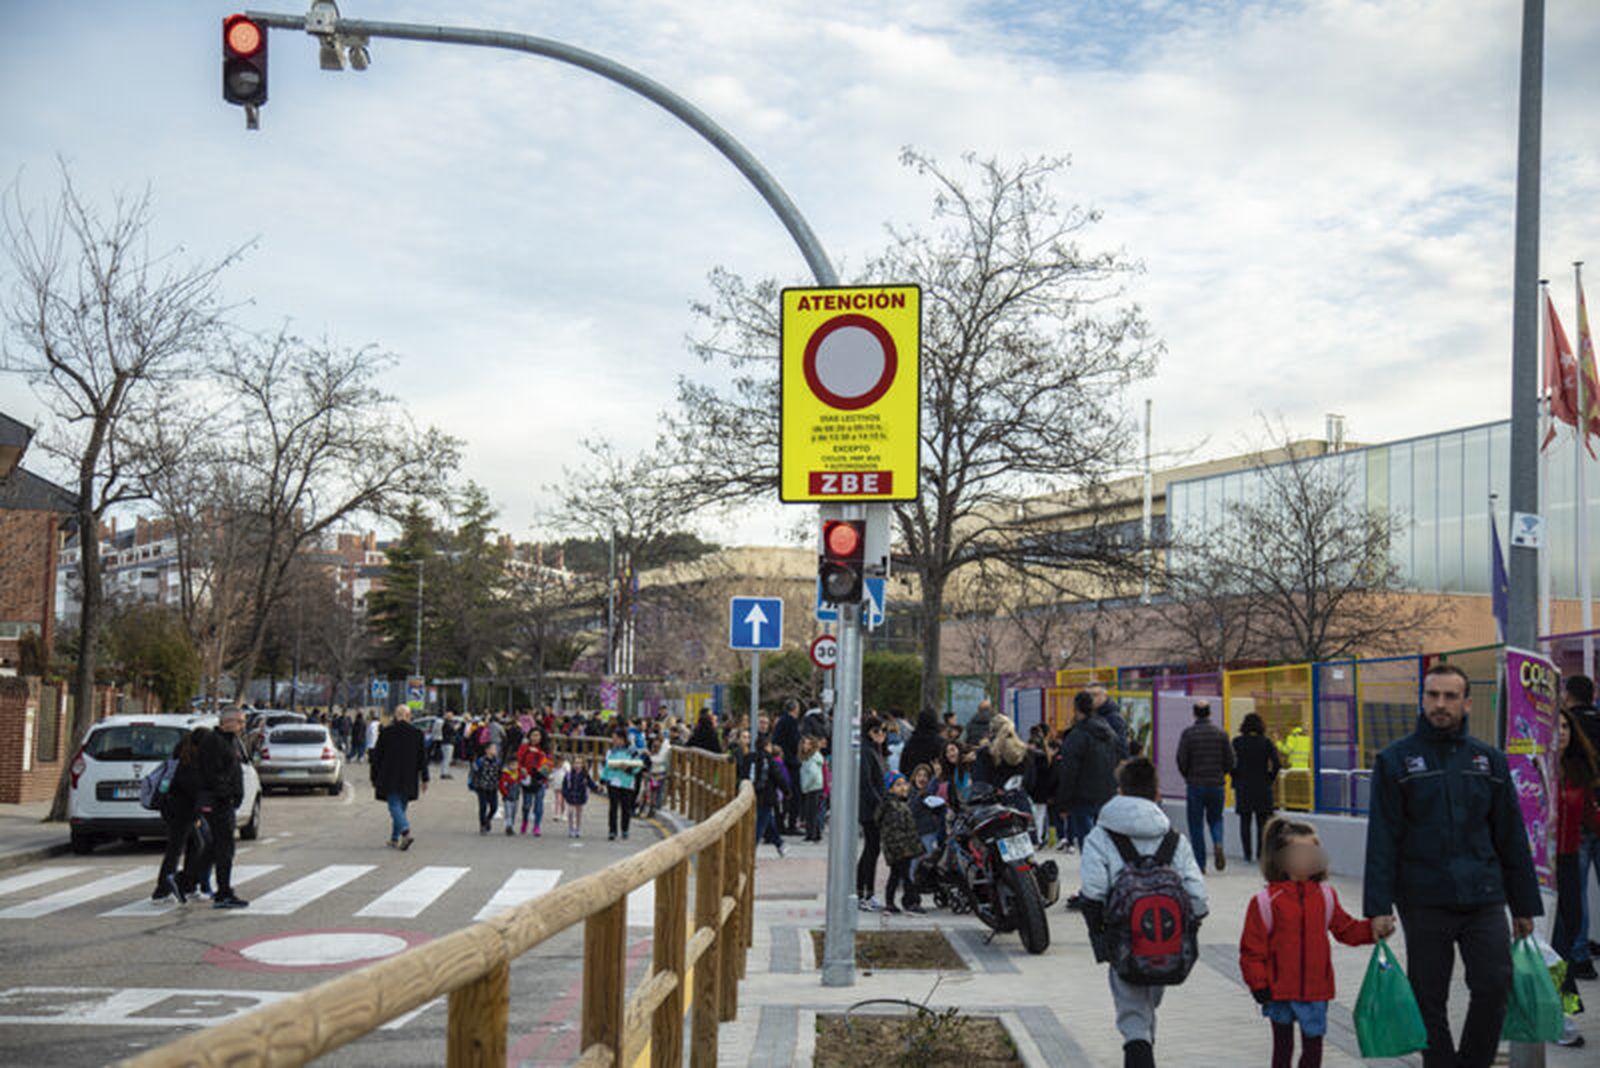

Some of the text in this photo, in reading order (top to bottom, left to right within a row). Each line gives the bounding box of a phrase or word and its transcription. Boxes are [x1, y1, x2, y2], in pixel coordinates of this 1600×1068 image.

[797, 288, 905, 311] ATENCIÓN
[832, 445, 871, 453] EXCEPTO
[820, 473, 880, 493] ZBE
[817, 646, 836, 658] 30
